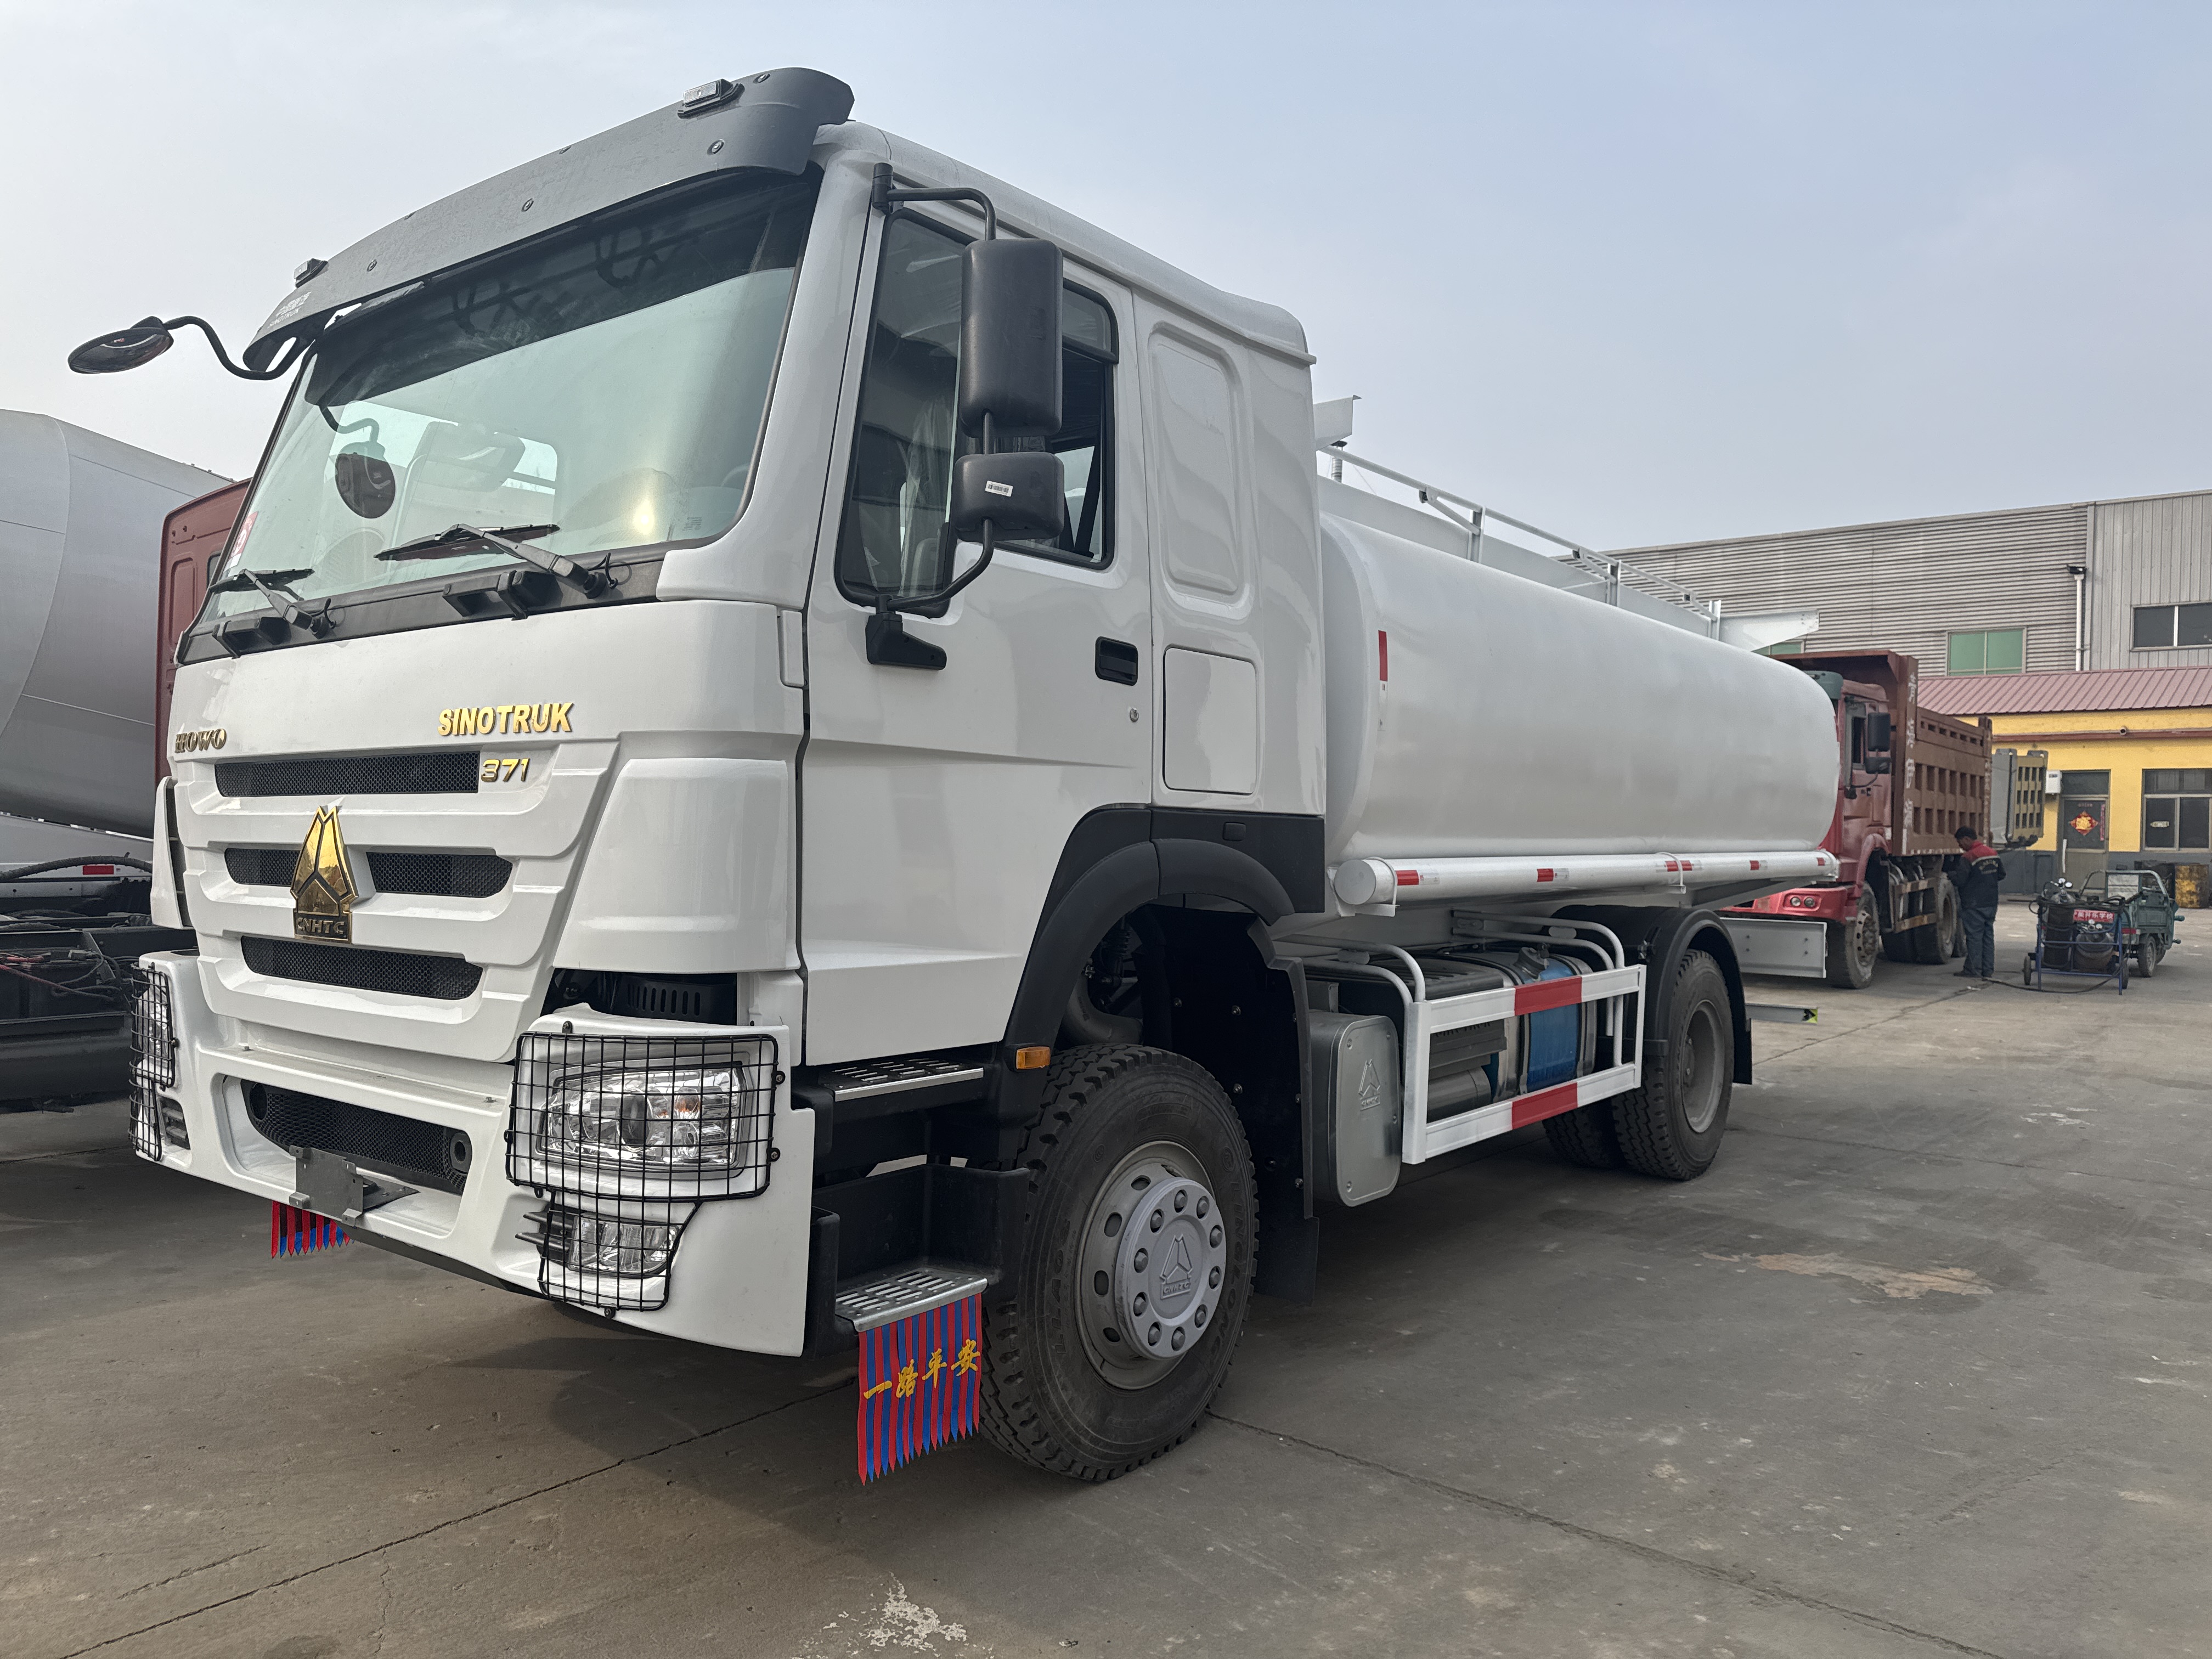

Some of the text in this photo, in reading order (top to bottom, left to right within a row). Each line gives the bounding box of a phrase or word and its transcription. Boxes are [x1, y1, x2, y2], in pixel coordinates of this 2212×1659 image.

[438, 702, 574, 736] SINOTRUK
[174, 729, 227, 753] HOWO
[481, 758, 530, 782] 371
[297, 917, 345, 934] CNHTC
[1164, 1281, 1190, 1294] CNHTC
[864, 1339, 980, 1399] 一路平安
